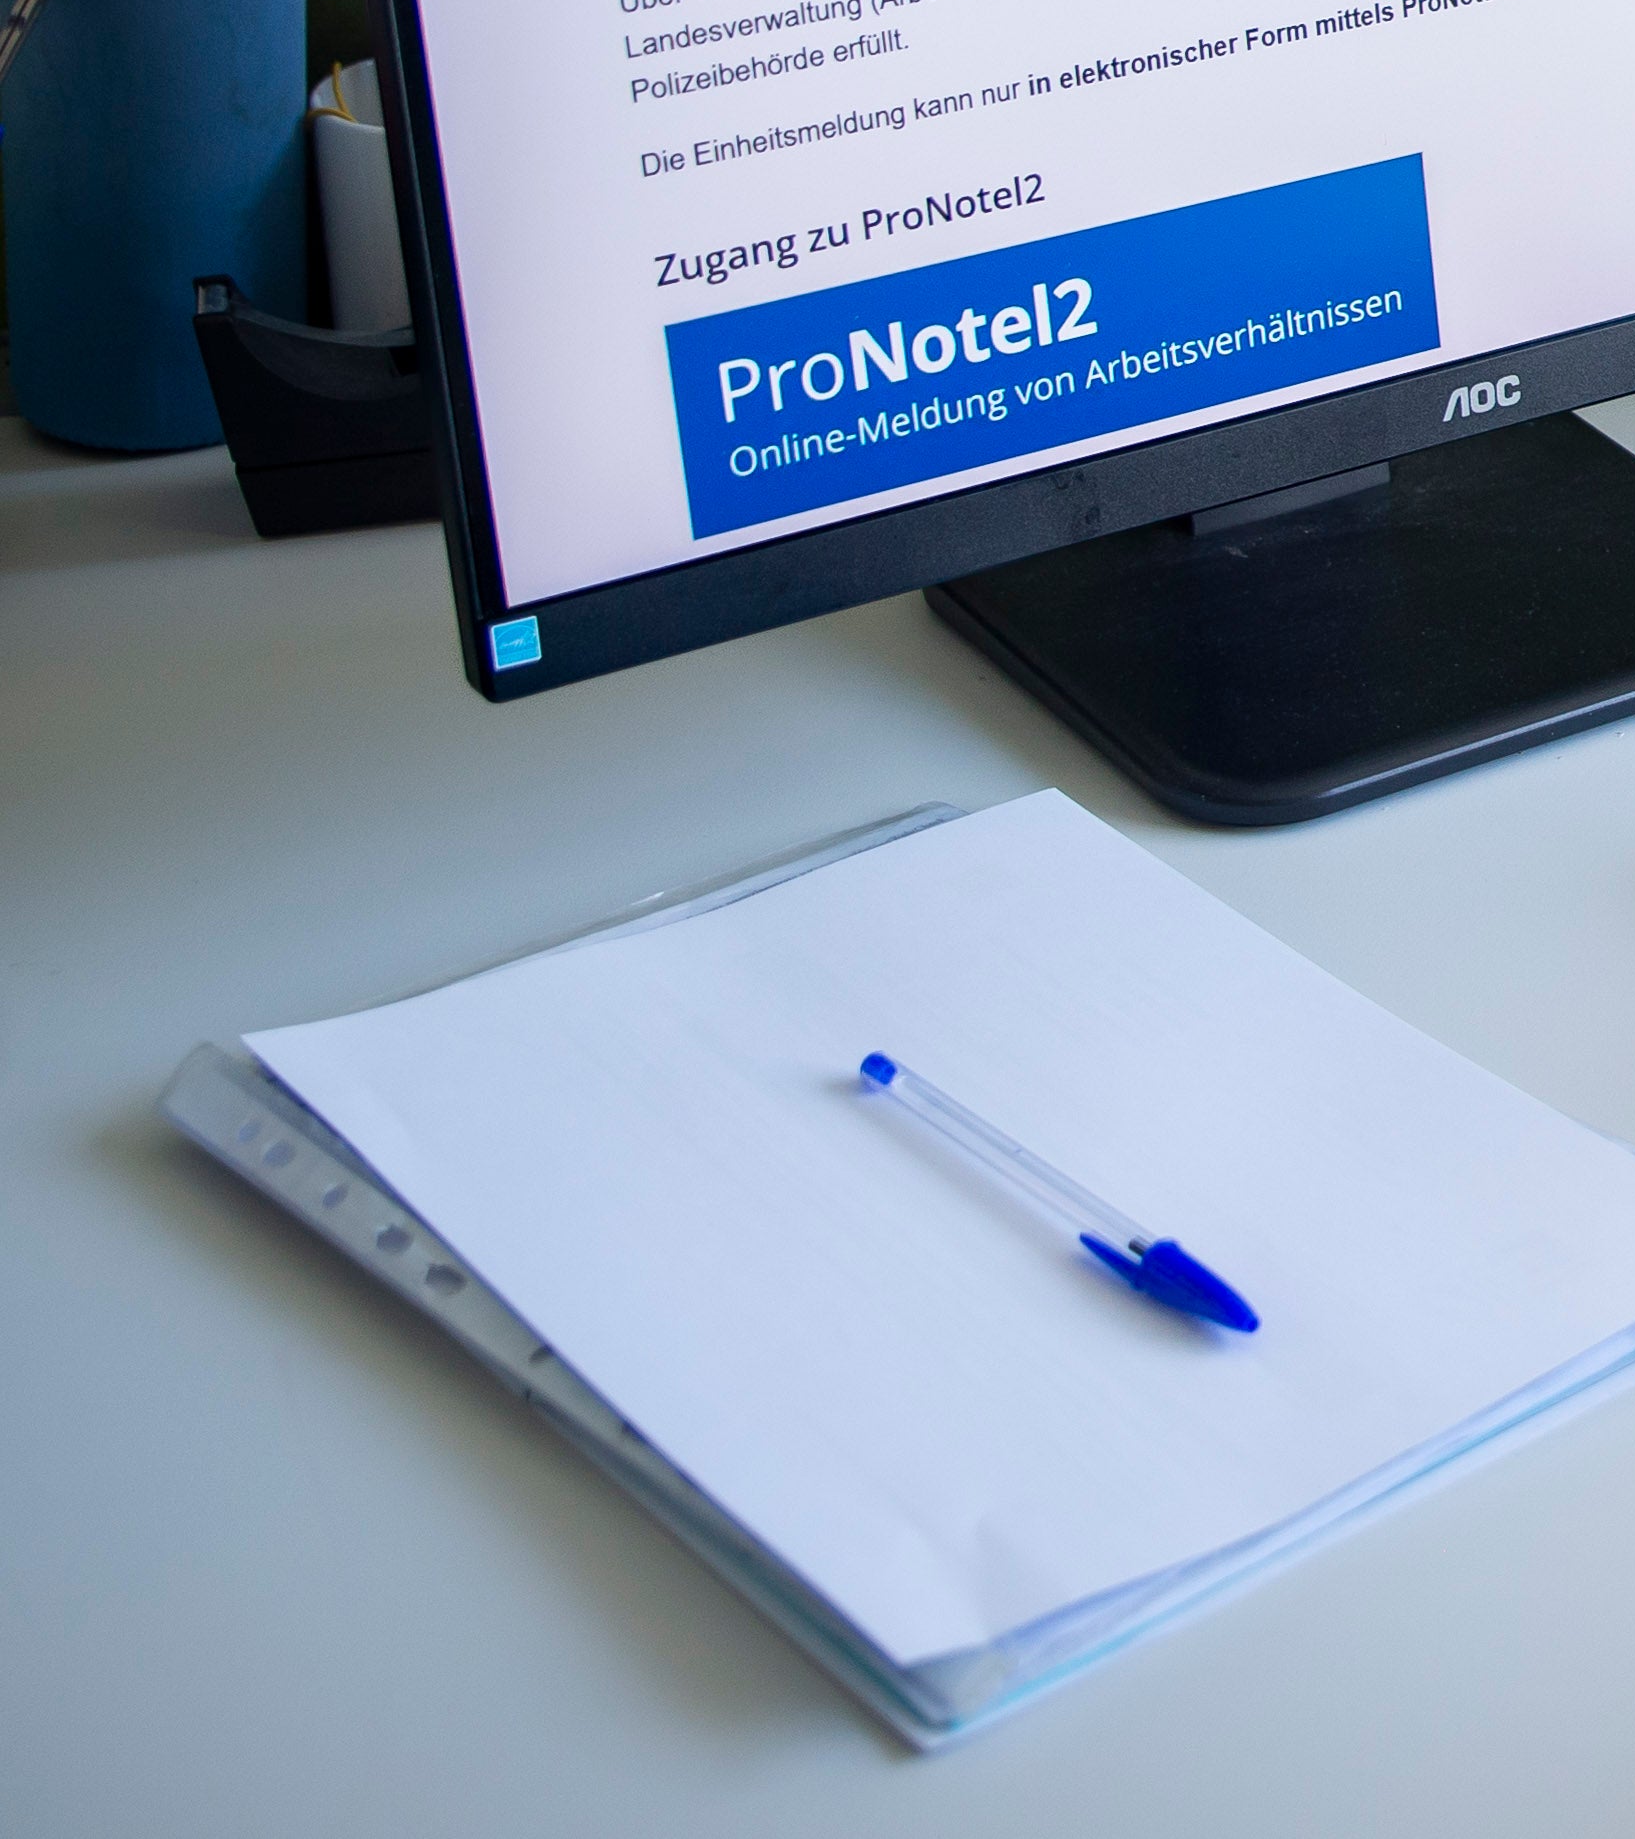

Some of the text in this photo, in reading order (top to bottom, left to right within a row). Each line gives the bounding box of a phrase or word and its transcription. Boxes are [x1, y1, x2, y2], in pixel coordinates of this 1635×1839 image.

[631, 28, 909, 103] Polizeibehörde erfüllt.
[641, 149, 685, 178] Die
[693, 106, 905, 166] Einheitsmeldung
[913, 92, 973, 120] kann
[982, 82, 1020, 106] nur
[1028, 74, 1051, 96] in
[1059, 37, 1238, 89] elektronischer
[1245, 23, 1308, 51] Form
[1315, 2, 1394, 36] mittels
[654, 173, 1045, 287] Zugang zu ProNotel2
[718, 277, 1098, 423] ProNotel2
[729, 290, 1402, 477] Online-Meldung von Arbeitsverhältnissen
[1442, 374, 1521, 422] AOC
